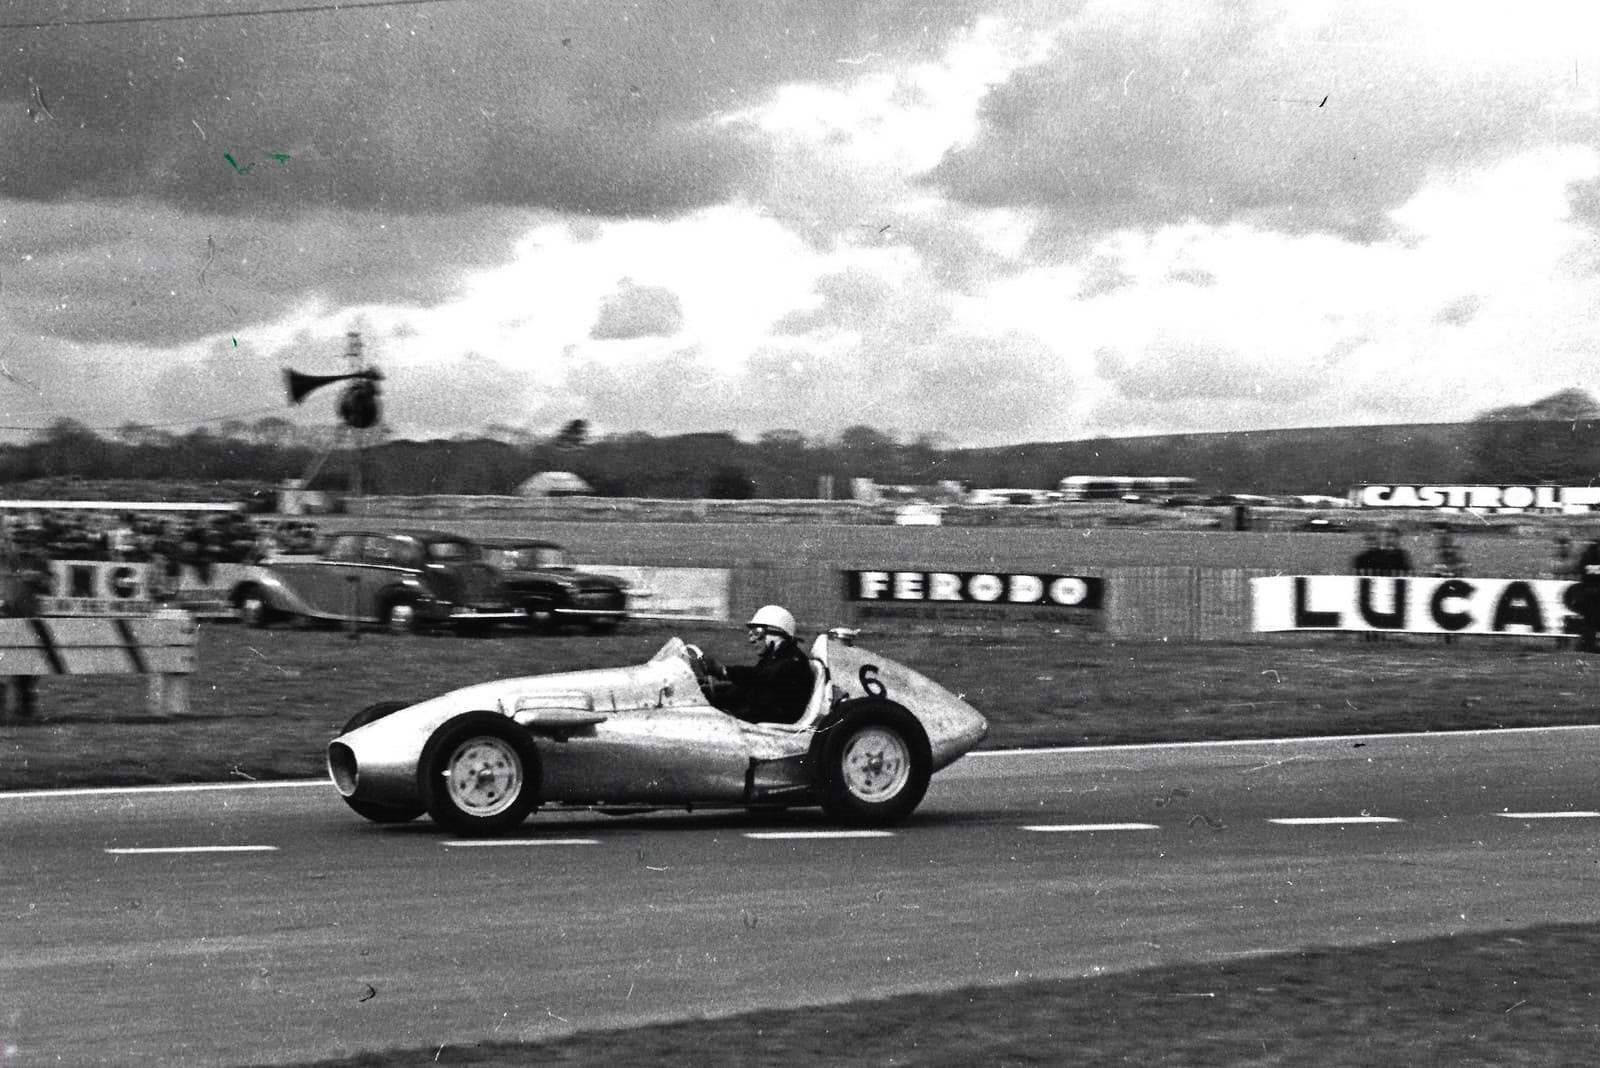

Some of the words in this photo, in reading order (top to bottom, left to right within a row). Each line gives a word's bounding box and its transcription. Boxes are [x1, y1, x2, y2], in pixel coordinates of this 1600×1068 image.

[1363, 486, 1562, 508] CASTROL
[859, 571, 1088, 605] FERODO
[859, 664, 887, 699] 6
